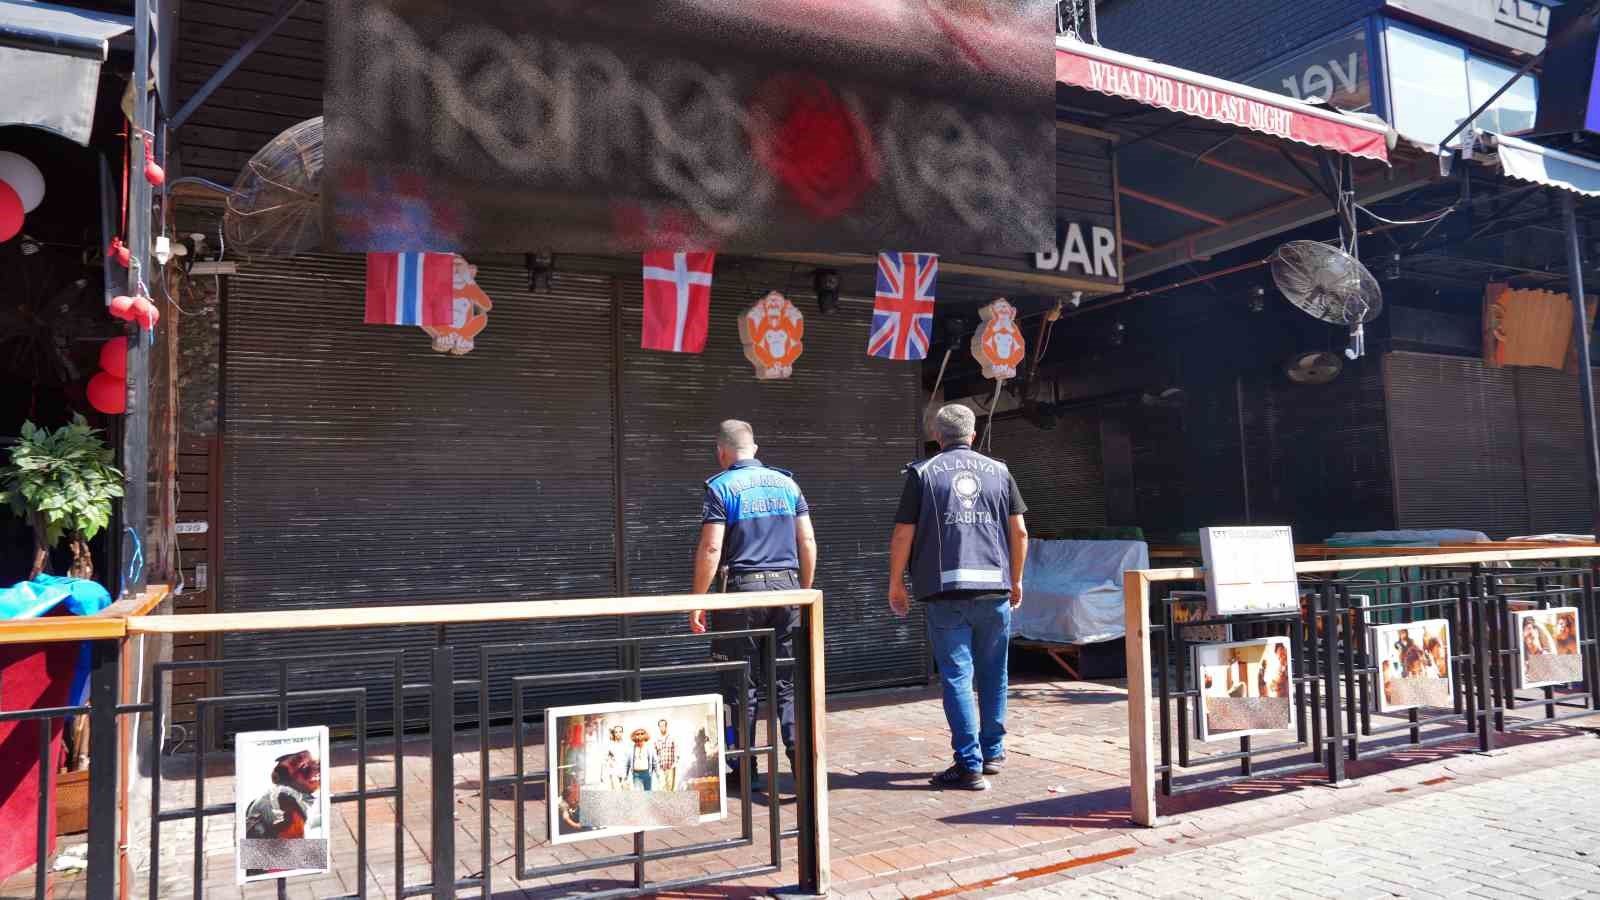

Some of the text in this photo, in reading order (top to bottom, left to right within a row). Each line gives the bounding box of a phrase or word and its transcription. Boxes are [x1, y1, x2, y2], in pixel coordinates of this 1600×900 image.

[1088, 60, 1292, 135] WHAT DID I DO LAST NIGHT
[932, 459, 995, 475] ALANYA
[944, 511, 992, 525] ZABITA
